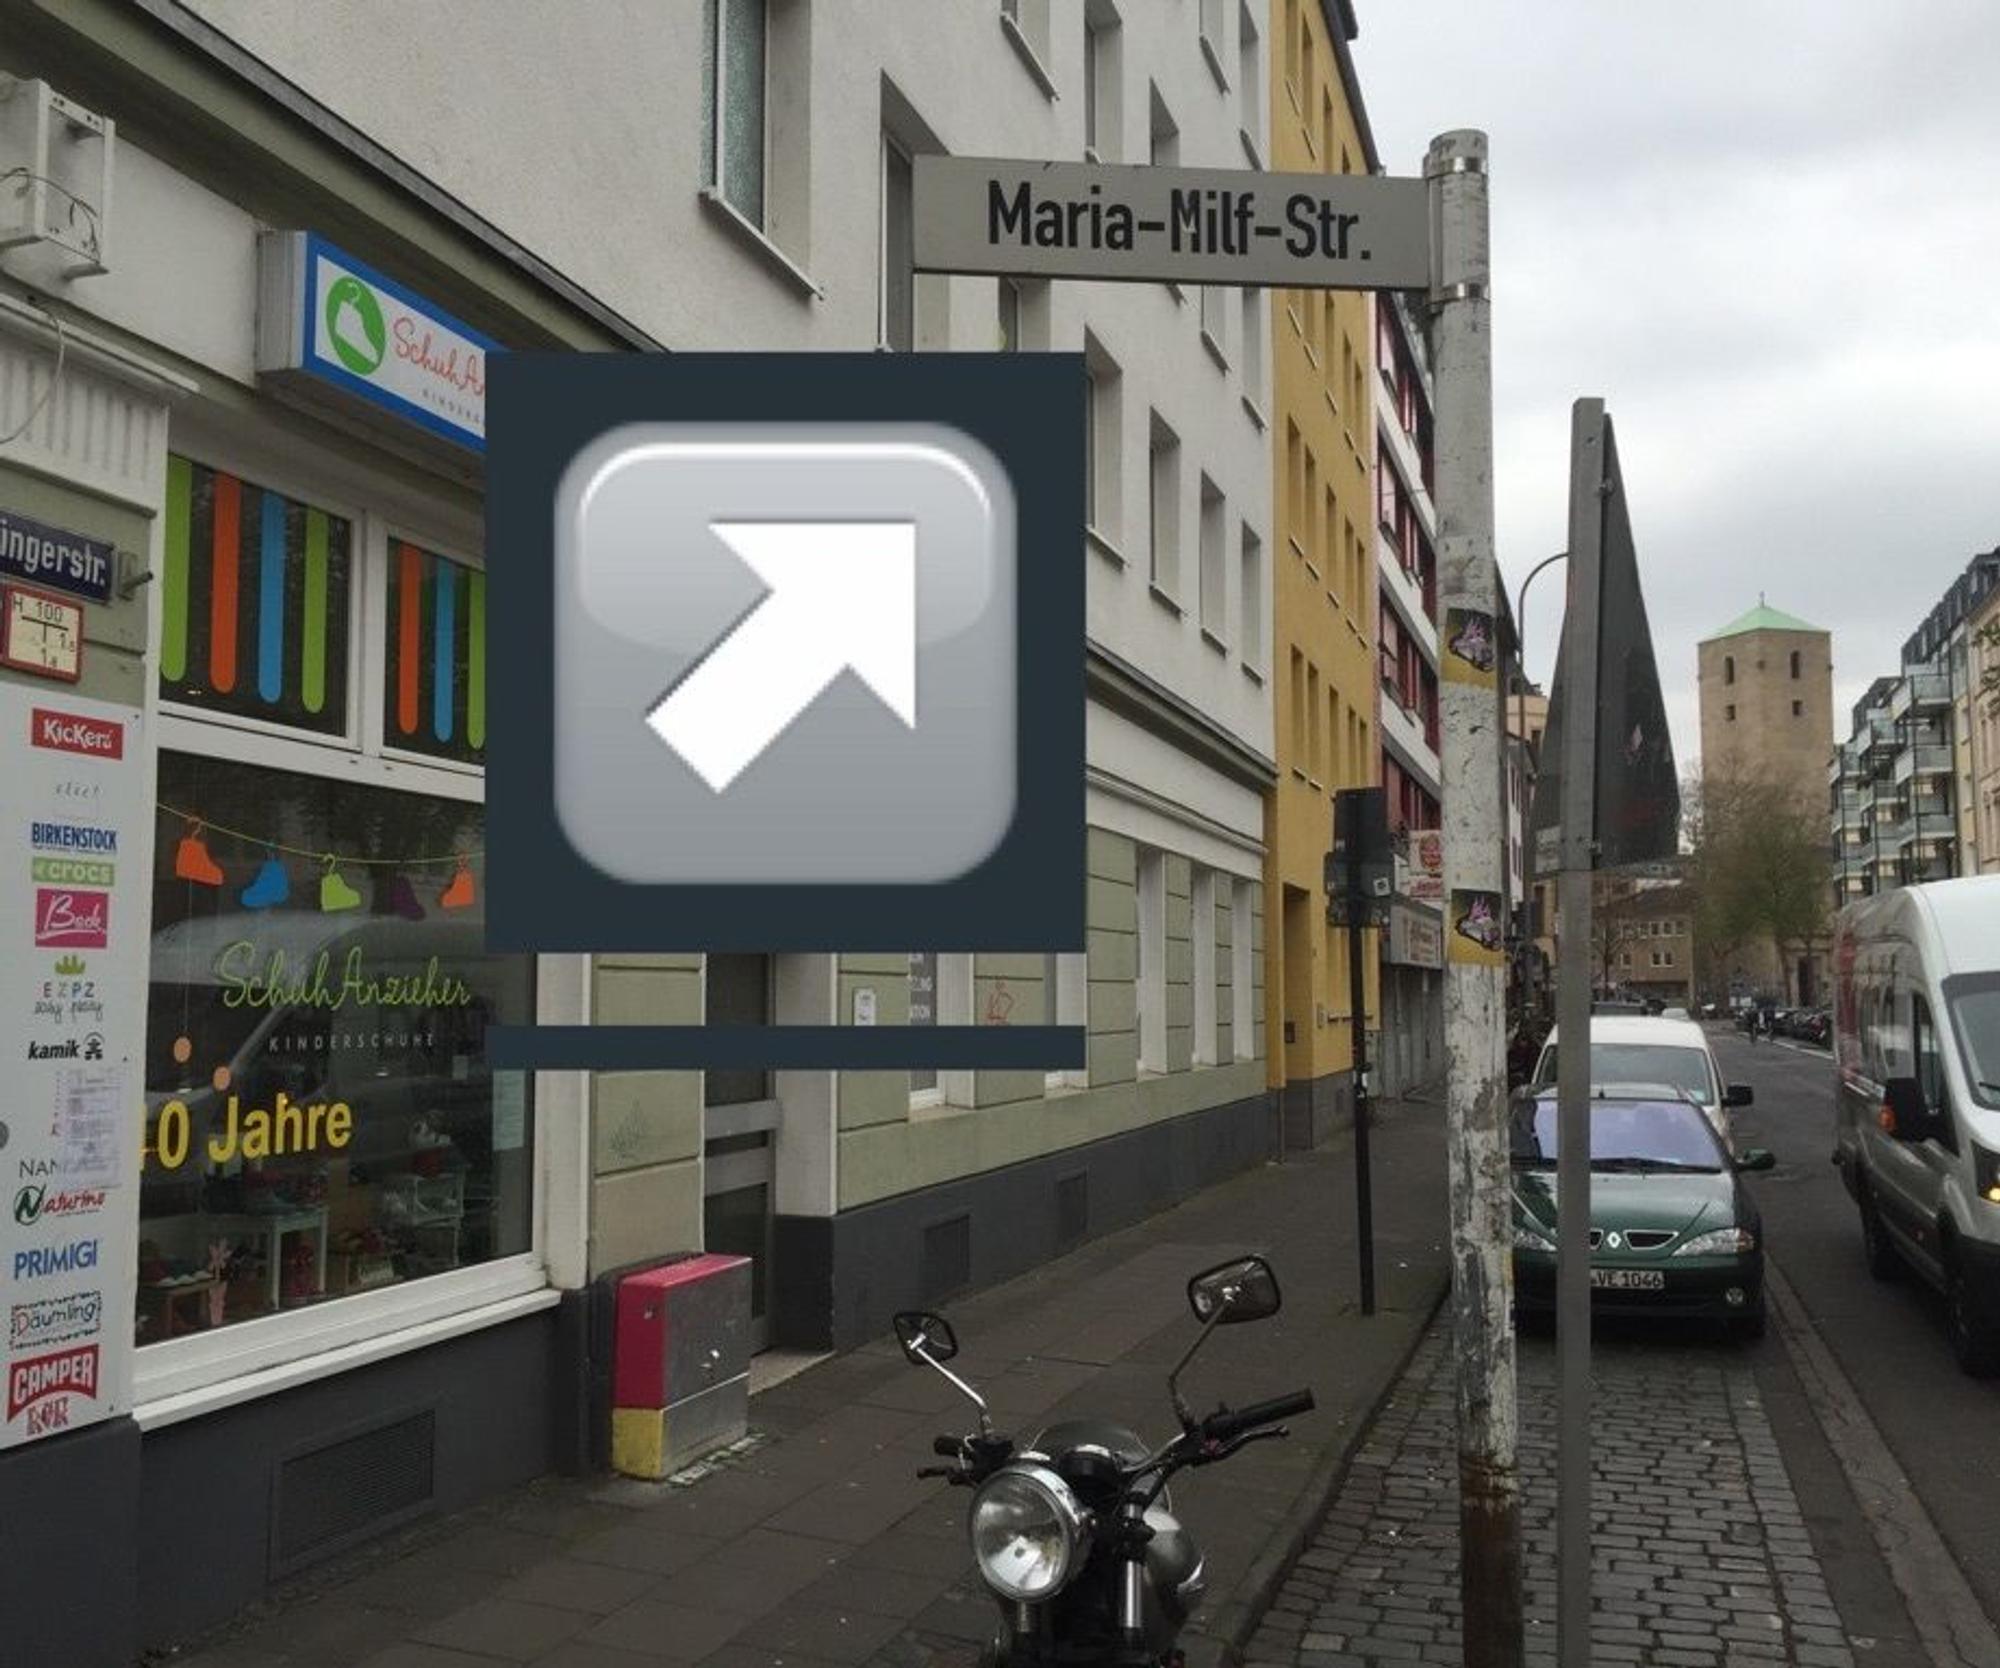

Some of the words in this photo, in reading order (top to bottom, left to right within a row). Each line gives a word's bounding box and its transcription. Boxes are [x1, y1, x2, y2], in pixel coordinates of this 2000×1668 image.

[988, 180, 1371, 260] Maria-Milf-Str.
[32, 822, 117, 850] BIRKENSTOCK
[28, 1040, 80, 1060] kamik
[209, 1093, 352, 1162] Jahre
[14, 1240, 98, 1281] PRIMIGI
[14, 1352, 94, 1406] CAMPER
